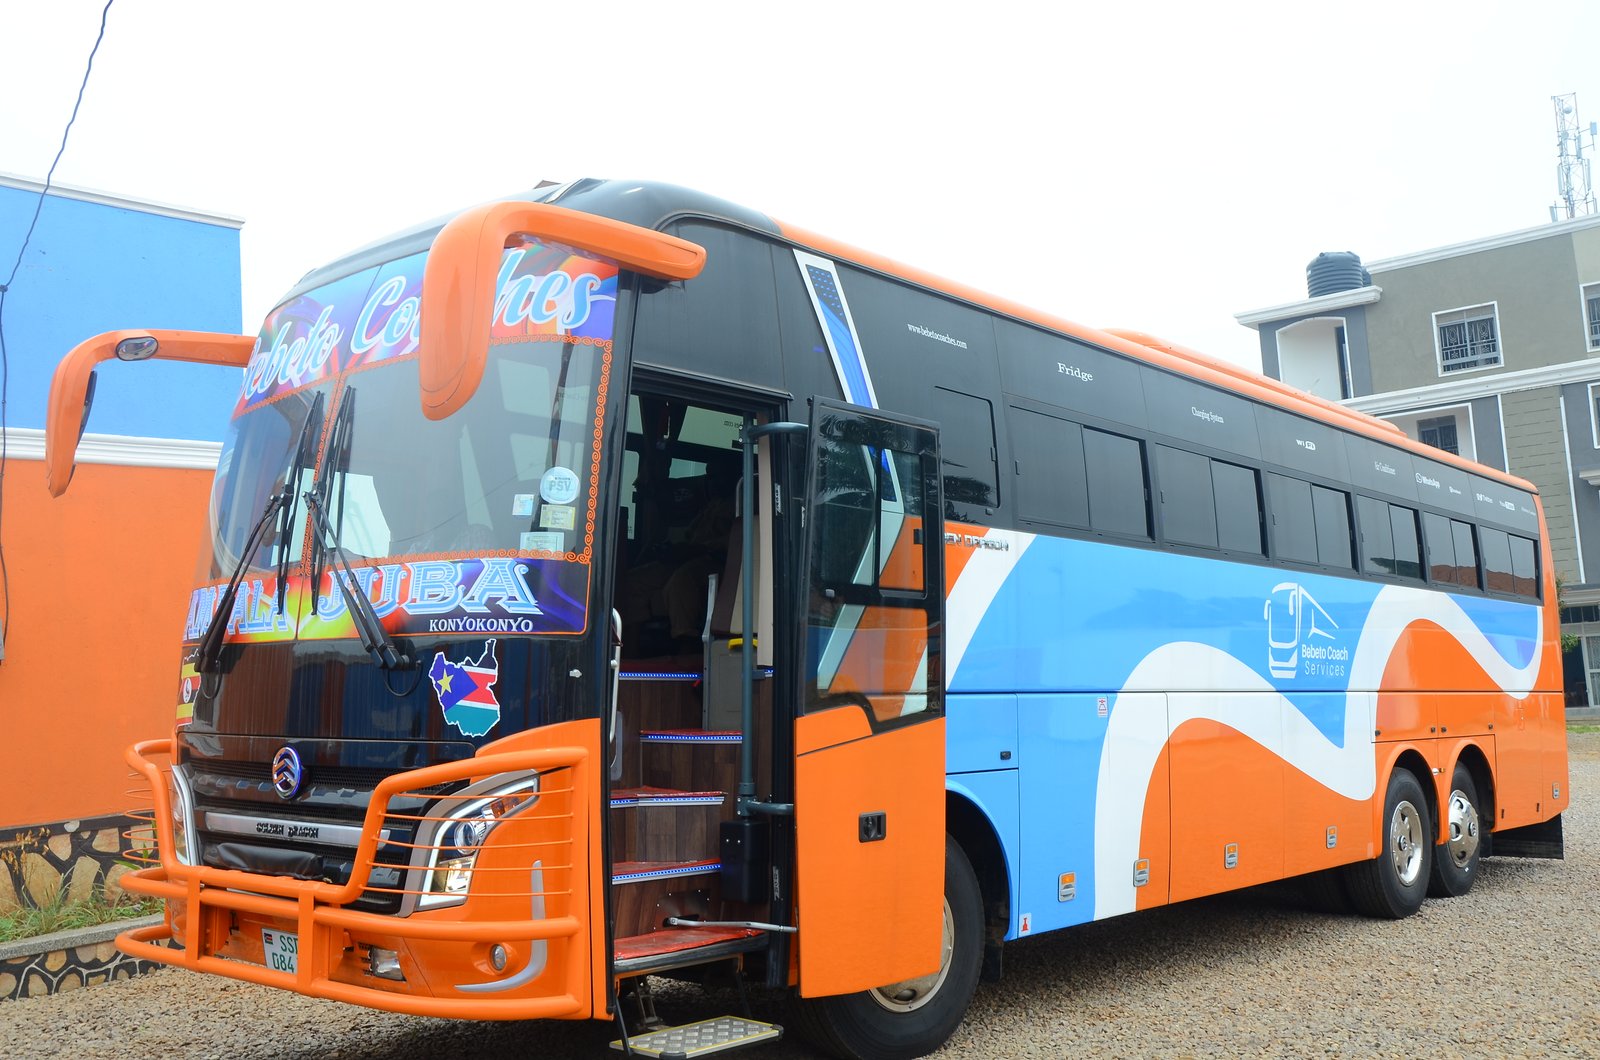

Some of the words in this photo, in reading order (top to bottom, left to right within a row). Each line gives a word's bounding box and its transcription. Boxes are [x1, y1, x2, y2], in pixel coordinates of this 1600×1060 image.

[350, 249, 616, 356] Cohes
[1057, 362, 1094, 382] Fridge
[549, 480, 572, 492] PSV
[183, 578, 290, 640] AMALA
[317, 558, 545, 622] JUBA
[429, 616, 534, 632] KONYOKONYO
[1301, 644, 1327, 660] Bebeto
[1327, 646, 1349, 661] Coach
[1304, 660, 1345, 677] Services
[287, 825, 320, 839] DRAGON
